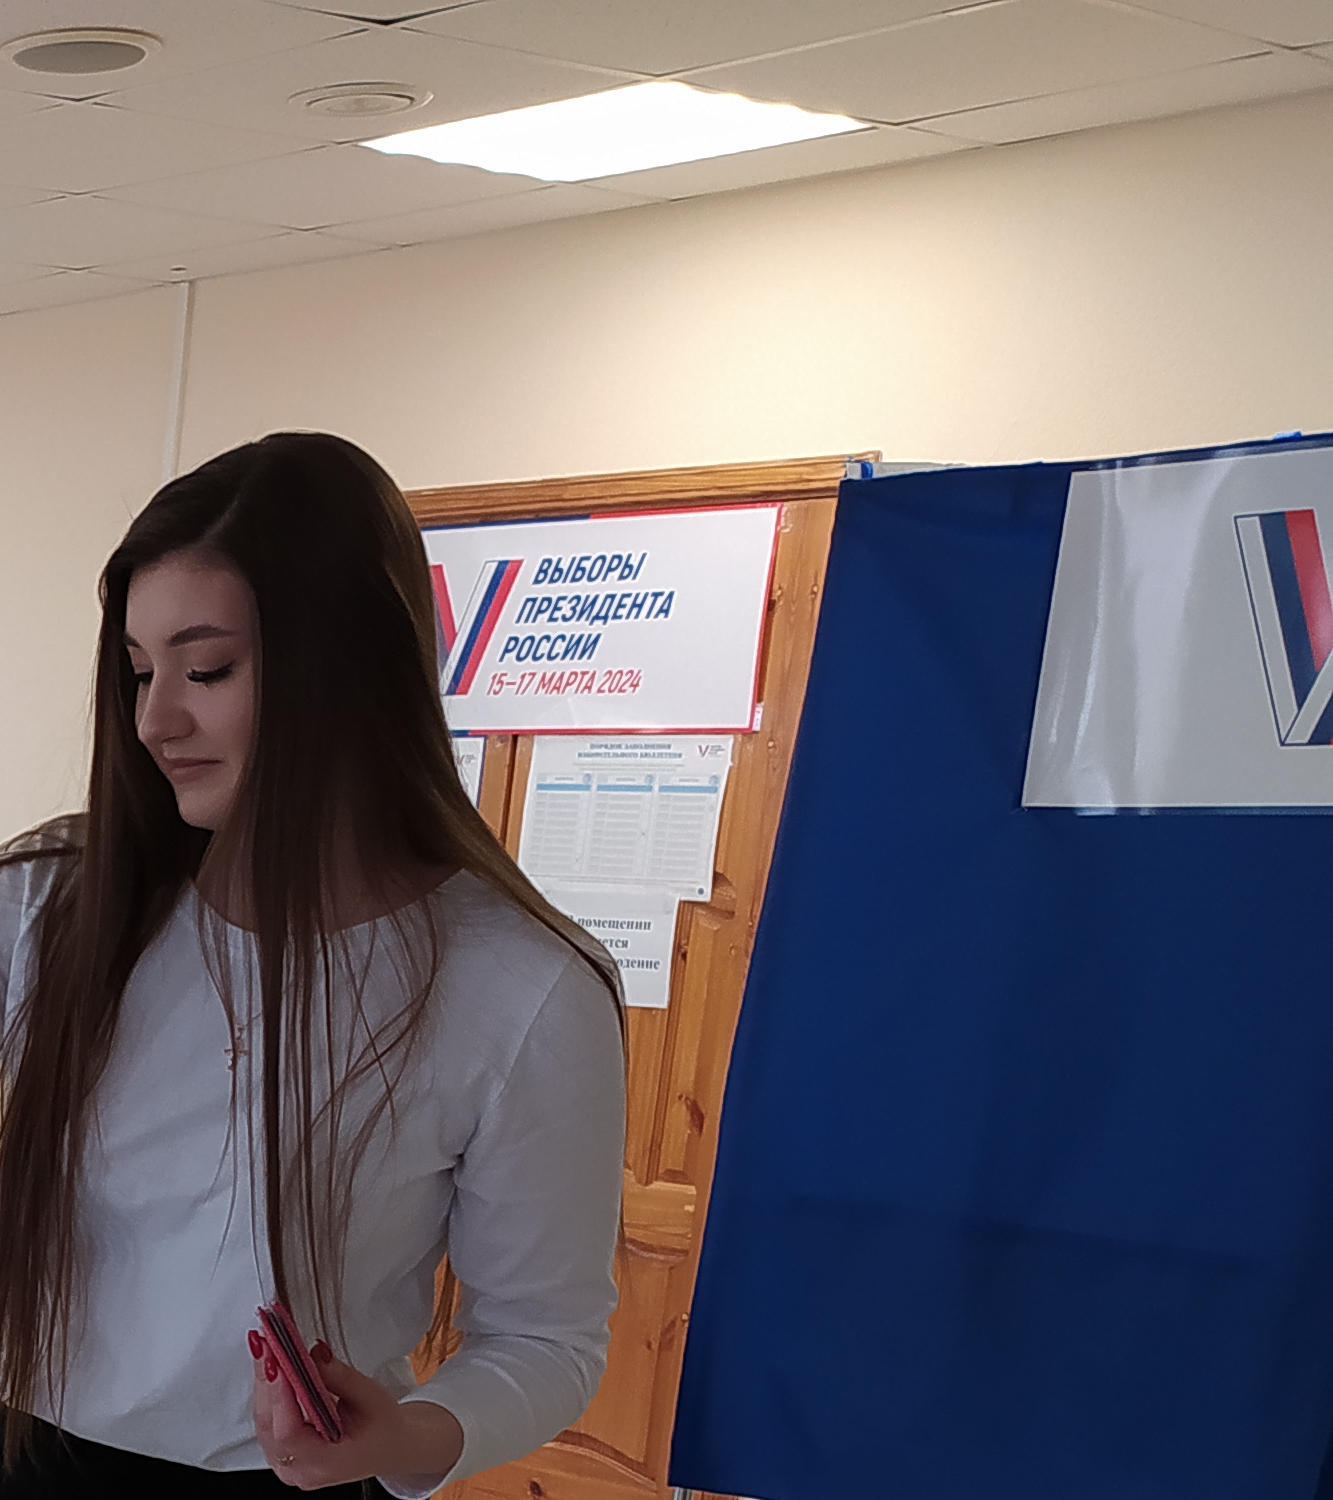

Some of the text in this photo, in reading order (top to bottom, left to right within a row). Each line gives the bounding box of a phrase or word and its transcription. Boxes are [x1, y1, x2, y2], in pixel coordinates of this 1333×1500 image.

[532, 552, 648, 586] ВЫБОРЫ
[515, 590, 677, 626] ПРЕЗИДЕНТА
[498, 633, 602, 663] РОССИИ
[535, 670, 597, 695] МАРТА
[596, 668, 643, 695] 2024
